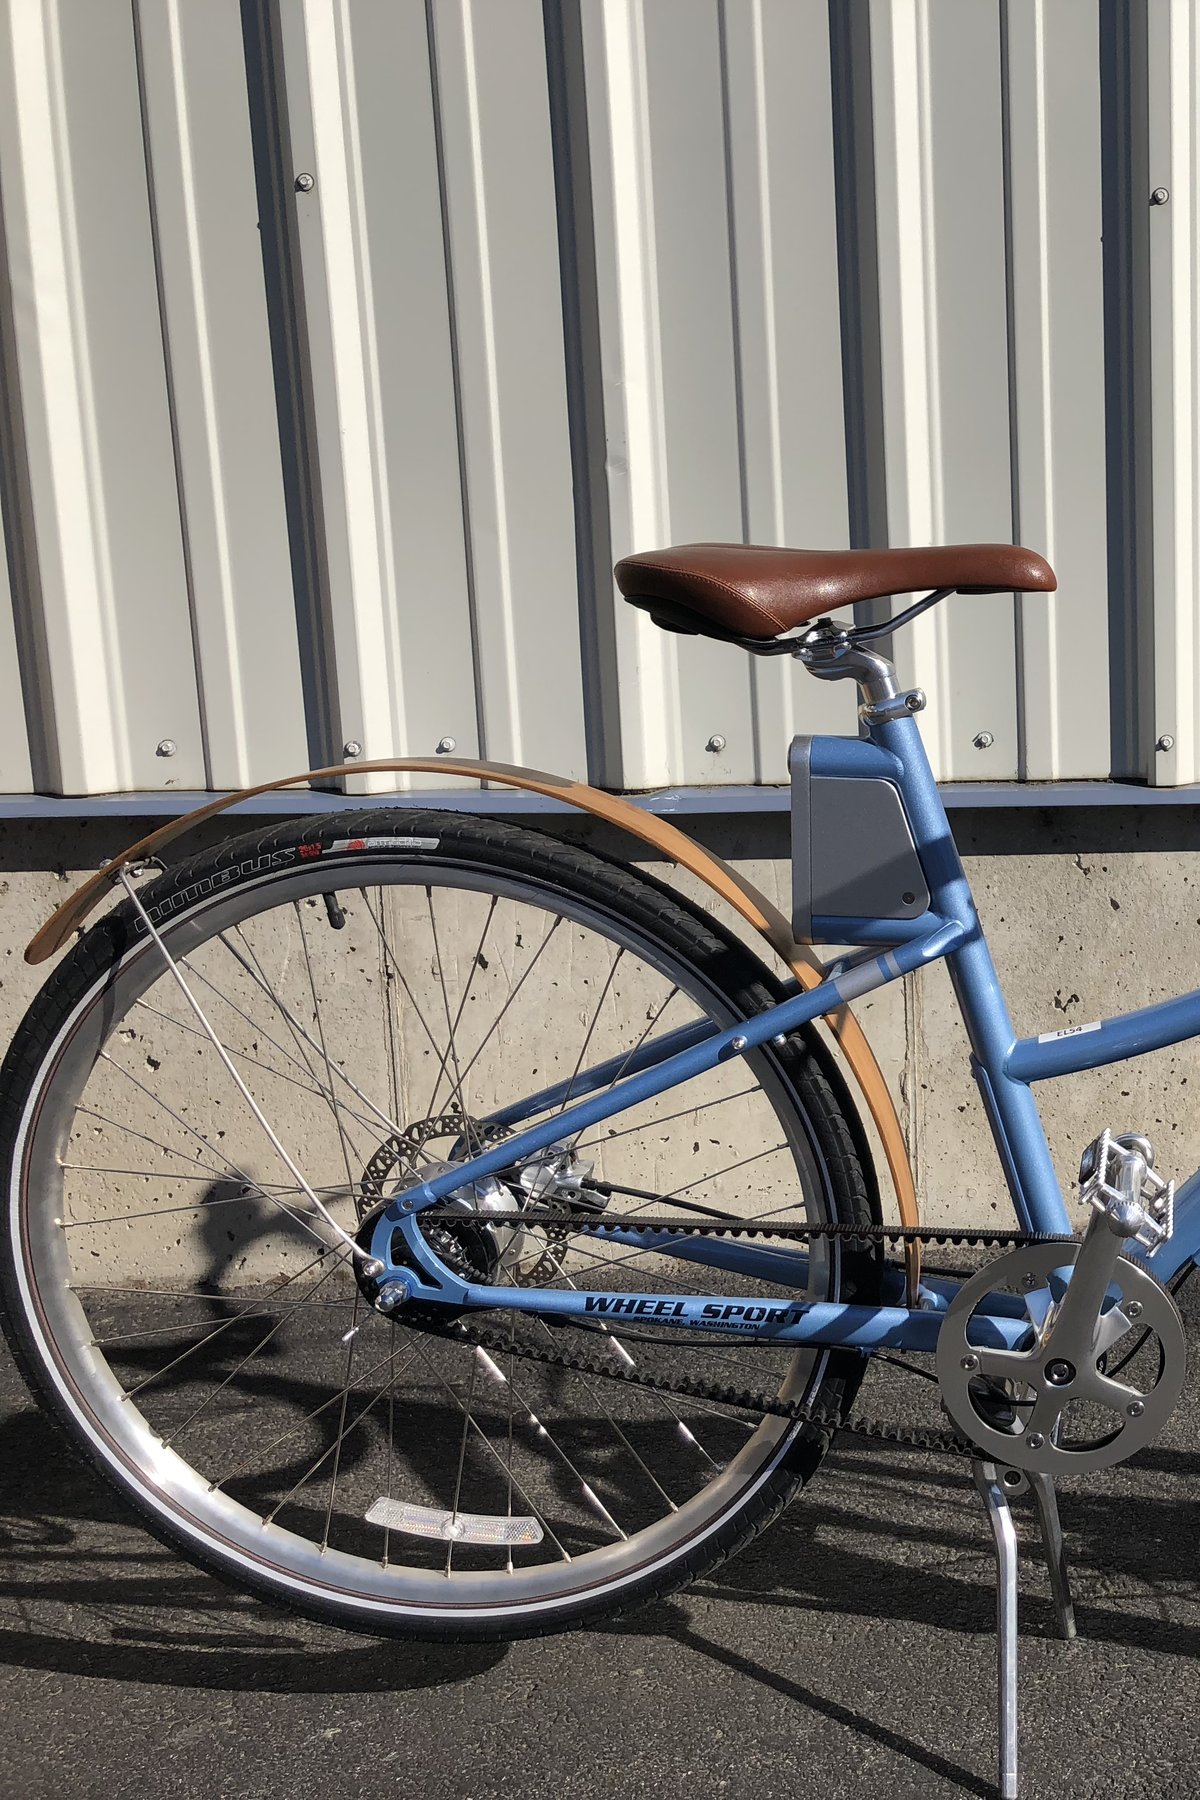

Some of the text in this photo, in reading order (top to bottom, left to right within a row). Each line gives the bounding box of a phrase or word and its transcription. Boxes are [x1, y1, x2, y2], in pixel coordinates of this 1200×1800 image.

[584, 1296, 810, 1325] WHEEL SPORT
[689, 1319, 761, 1331] WASHINGTON
